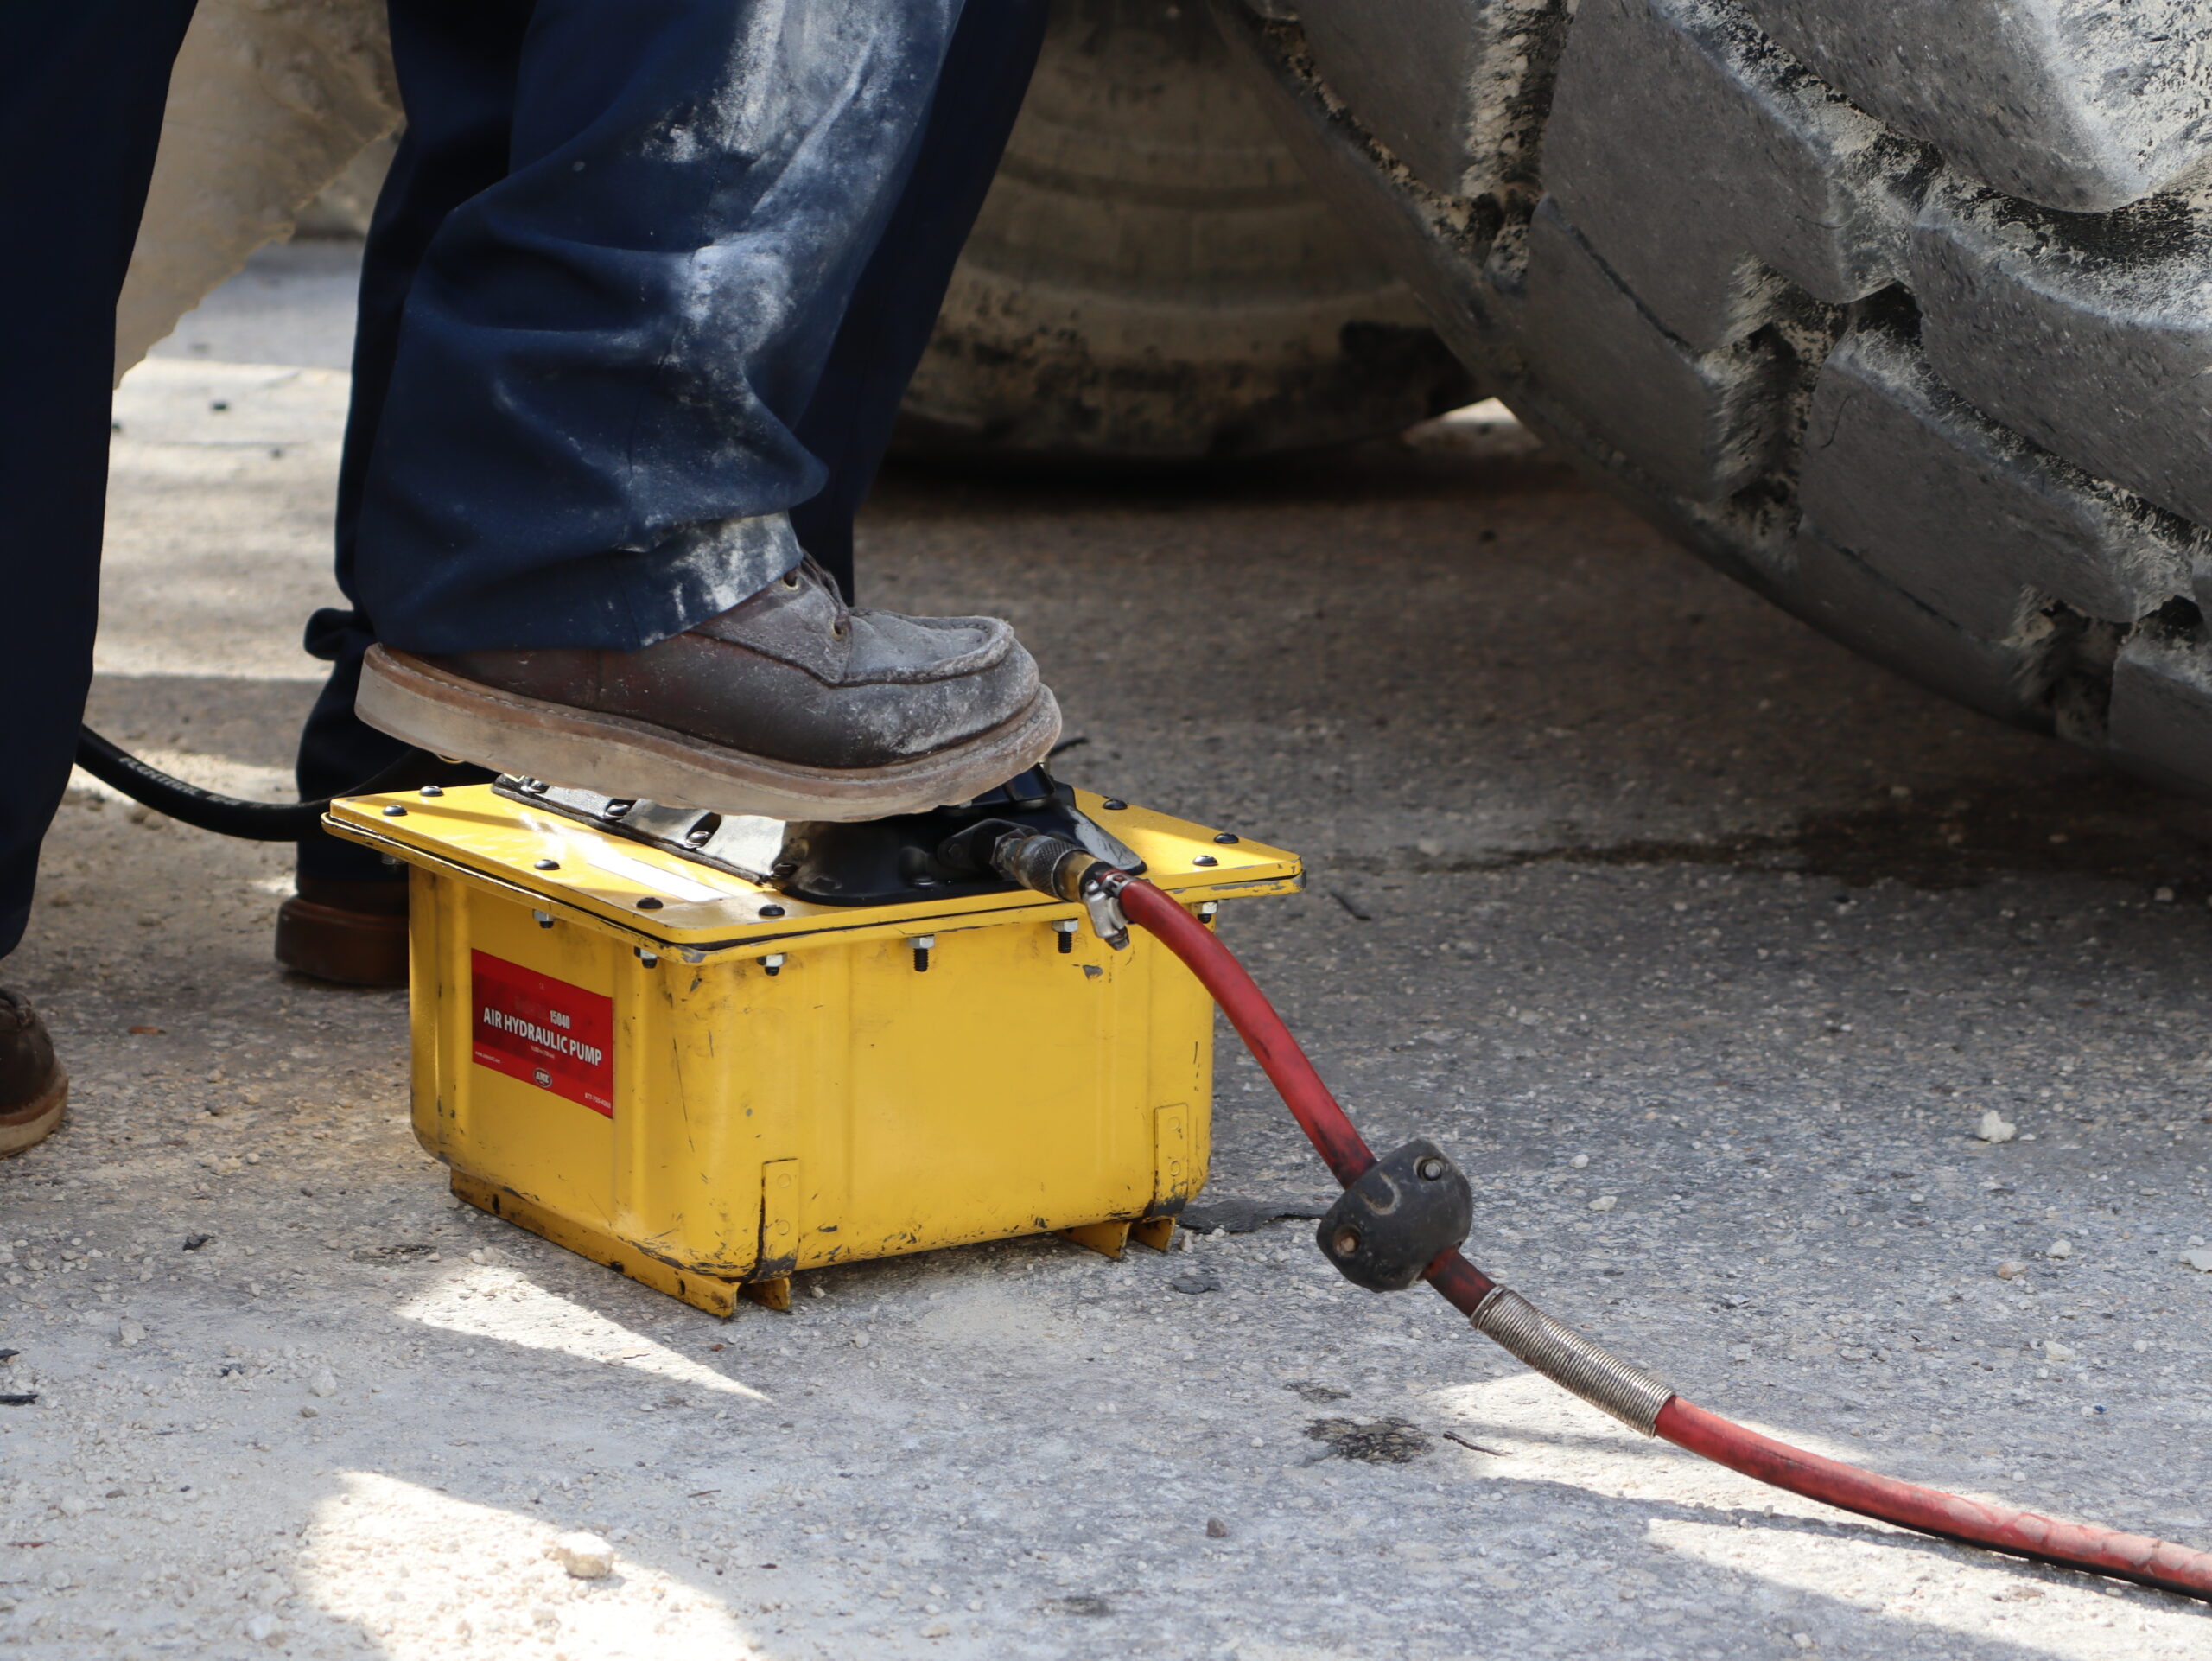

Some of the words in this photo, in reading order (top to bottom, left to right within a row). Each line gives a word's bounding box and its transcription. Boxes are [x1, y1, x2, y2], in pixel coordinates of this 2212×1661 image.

[483, 1007, 502, 1029] AIR
[504, 1014, 568, 1054] HYDRAULIC
[569, 1039, 602, 1066] PUMP
[550, 1009, 570, 1029] 15040
